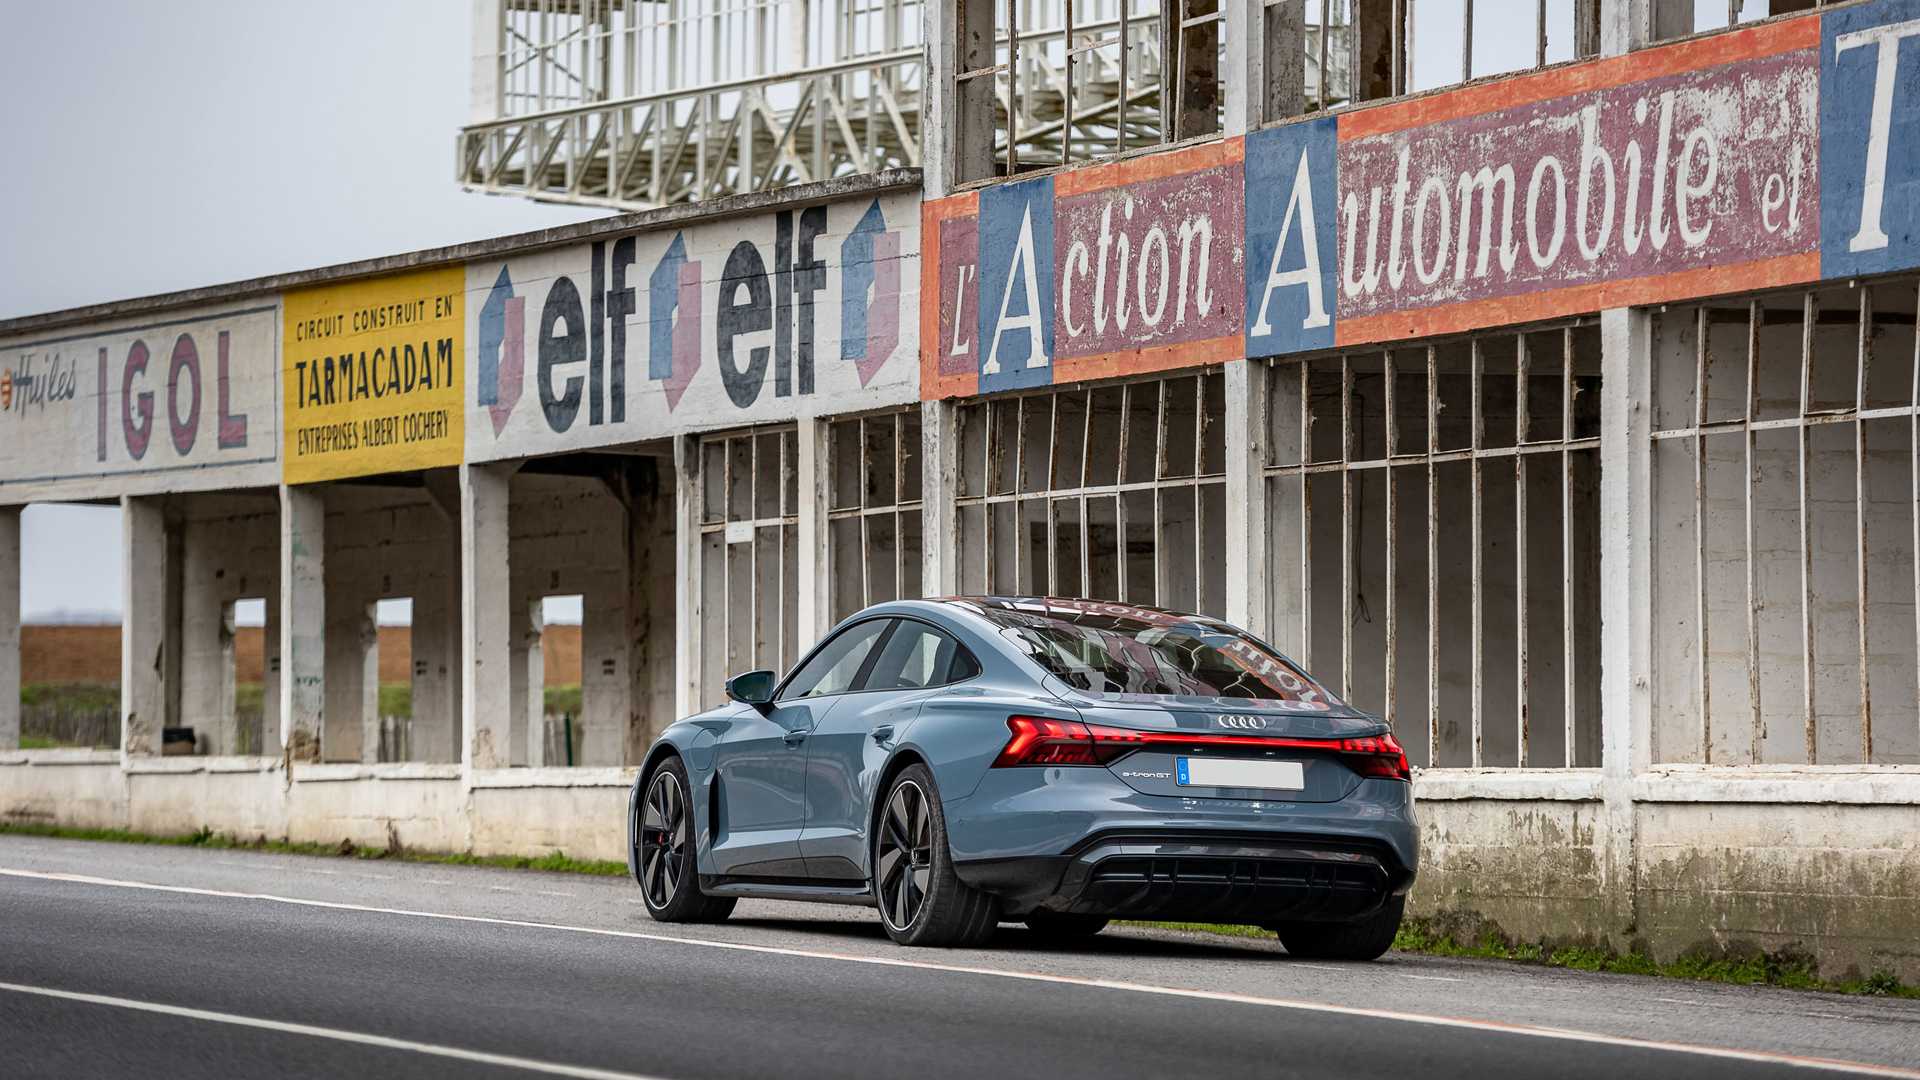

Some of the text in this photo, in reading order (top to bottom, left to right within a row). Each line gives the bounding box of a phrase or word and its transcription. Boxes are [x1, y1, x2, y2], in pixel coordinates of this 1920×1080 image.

[1251, 88, 1718, 338] Automobile
[296, 295, 453, 342] CIRCUIT CONSTRUIT EN
[537, 236, 636, 434] elf
[716, 205, 827, 409] elf
[14, 331, 248, 462] Huiles IGOL
[295, 337, 453, 409] TARMACADAM
[298, 409, 449, 457] ENTREPRISES ALBERT COCHERY
[1180, 773, 1187, 781] D
